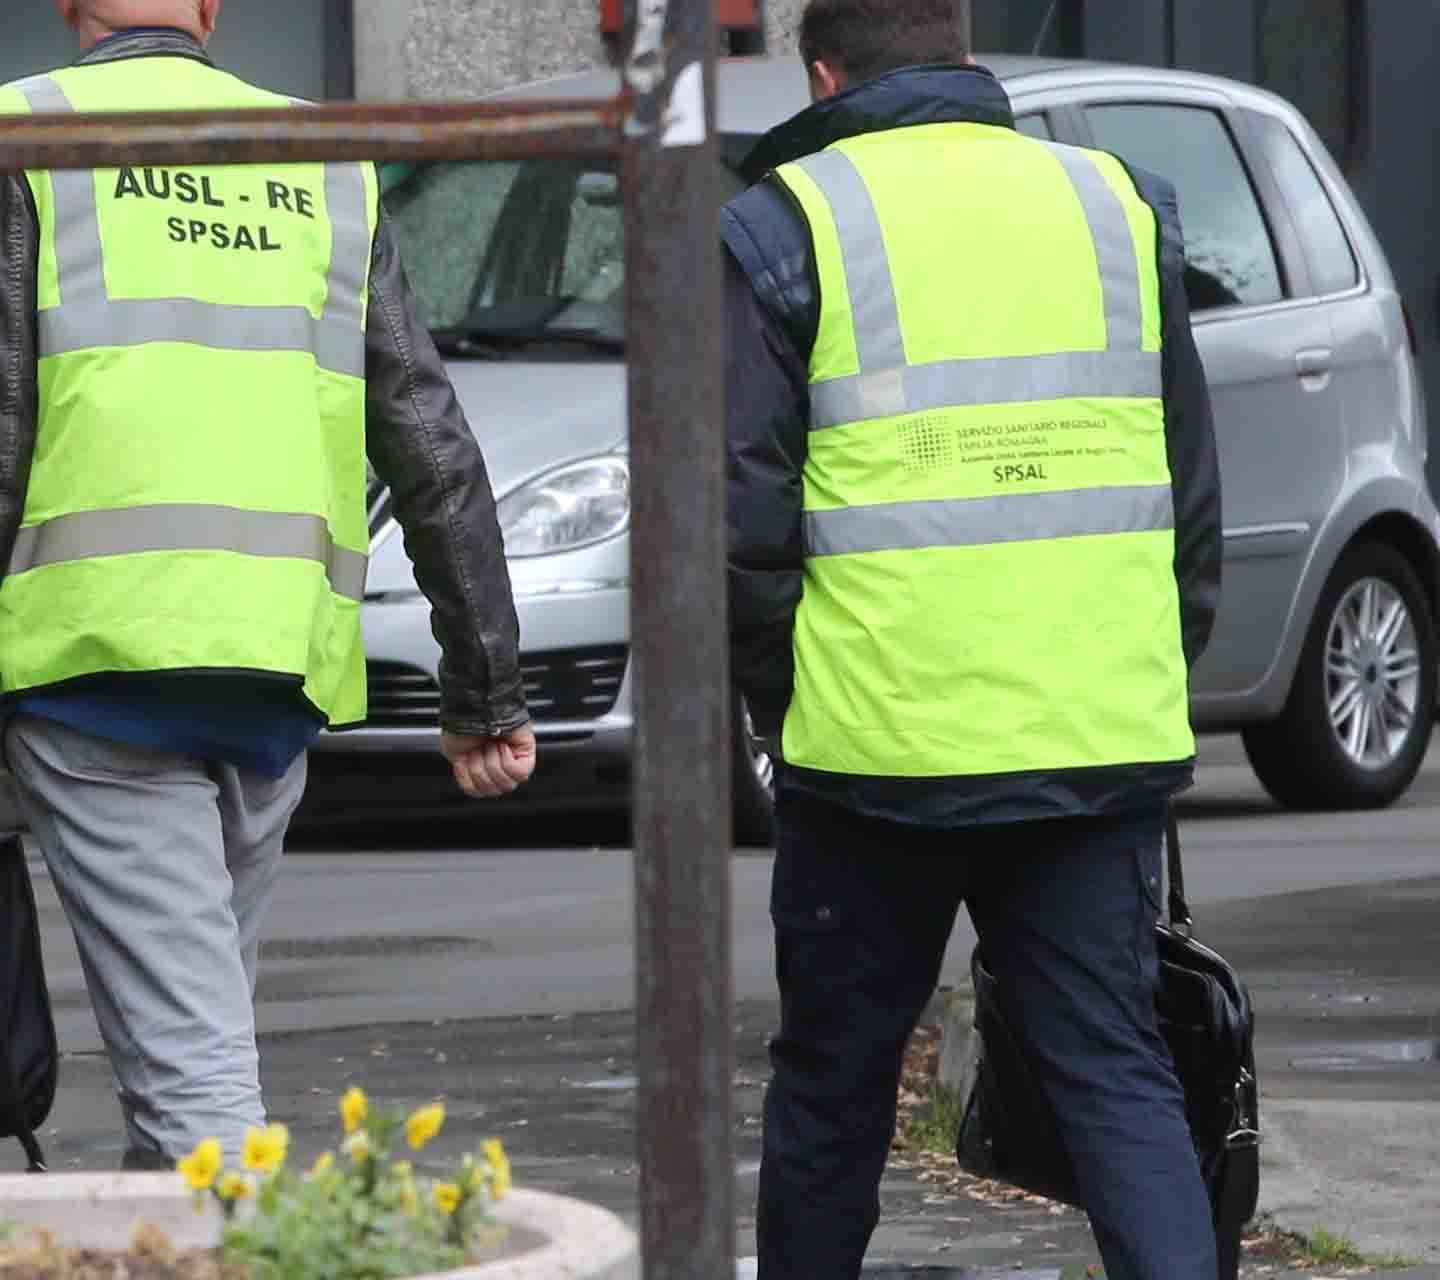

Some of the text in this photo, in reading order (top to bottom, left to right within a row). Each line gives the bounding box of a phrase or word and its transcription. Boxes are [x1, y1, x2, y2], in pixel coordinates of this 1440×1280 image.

[113, 167, 225, 207] AUSL
[266, 180, 315, 220] RE
[167, 216, 281, 251] SPSAL
[992, 463, 1048, 483] SPSAL
